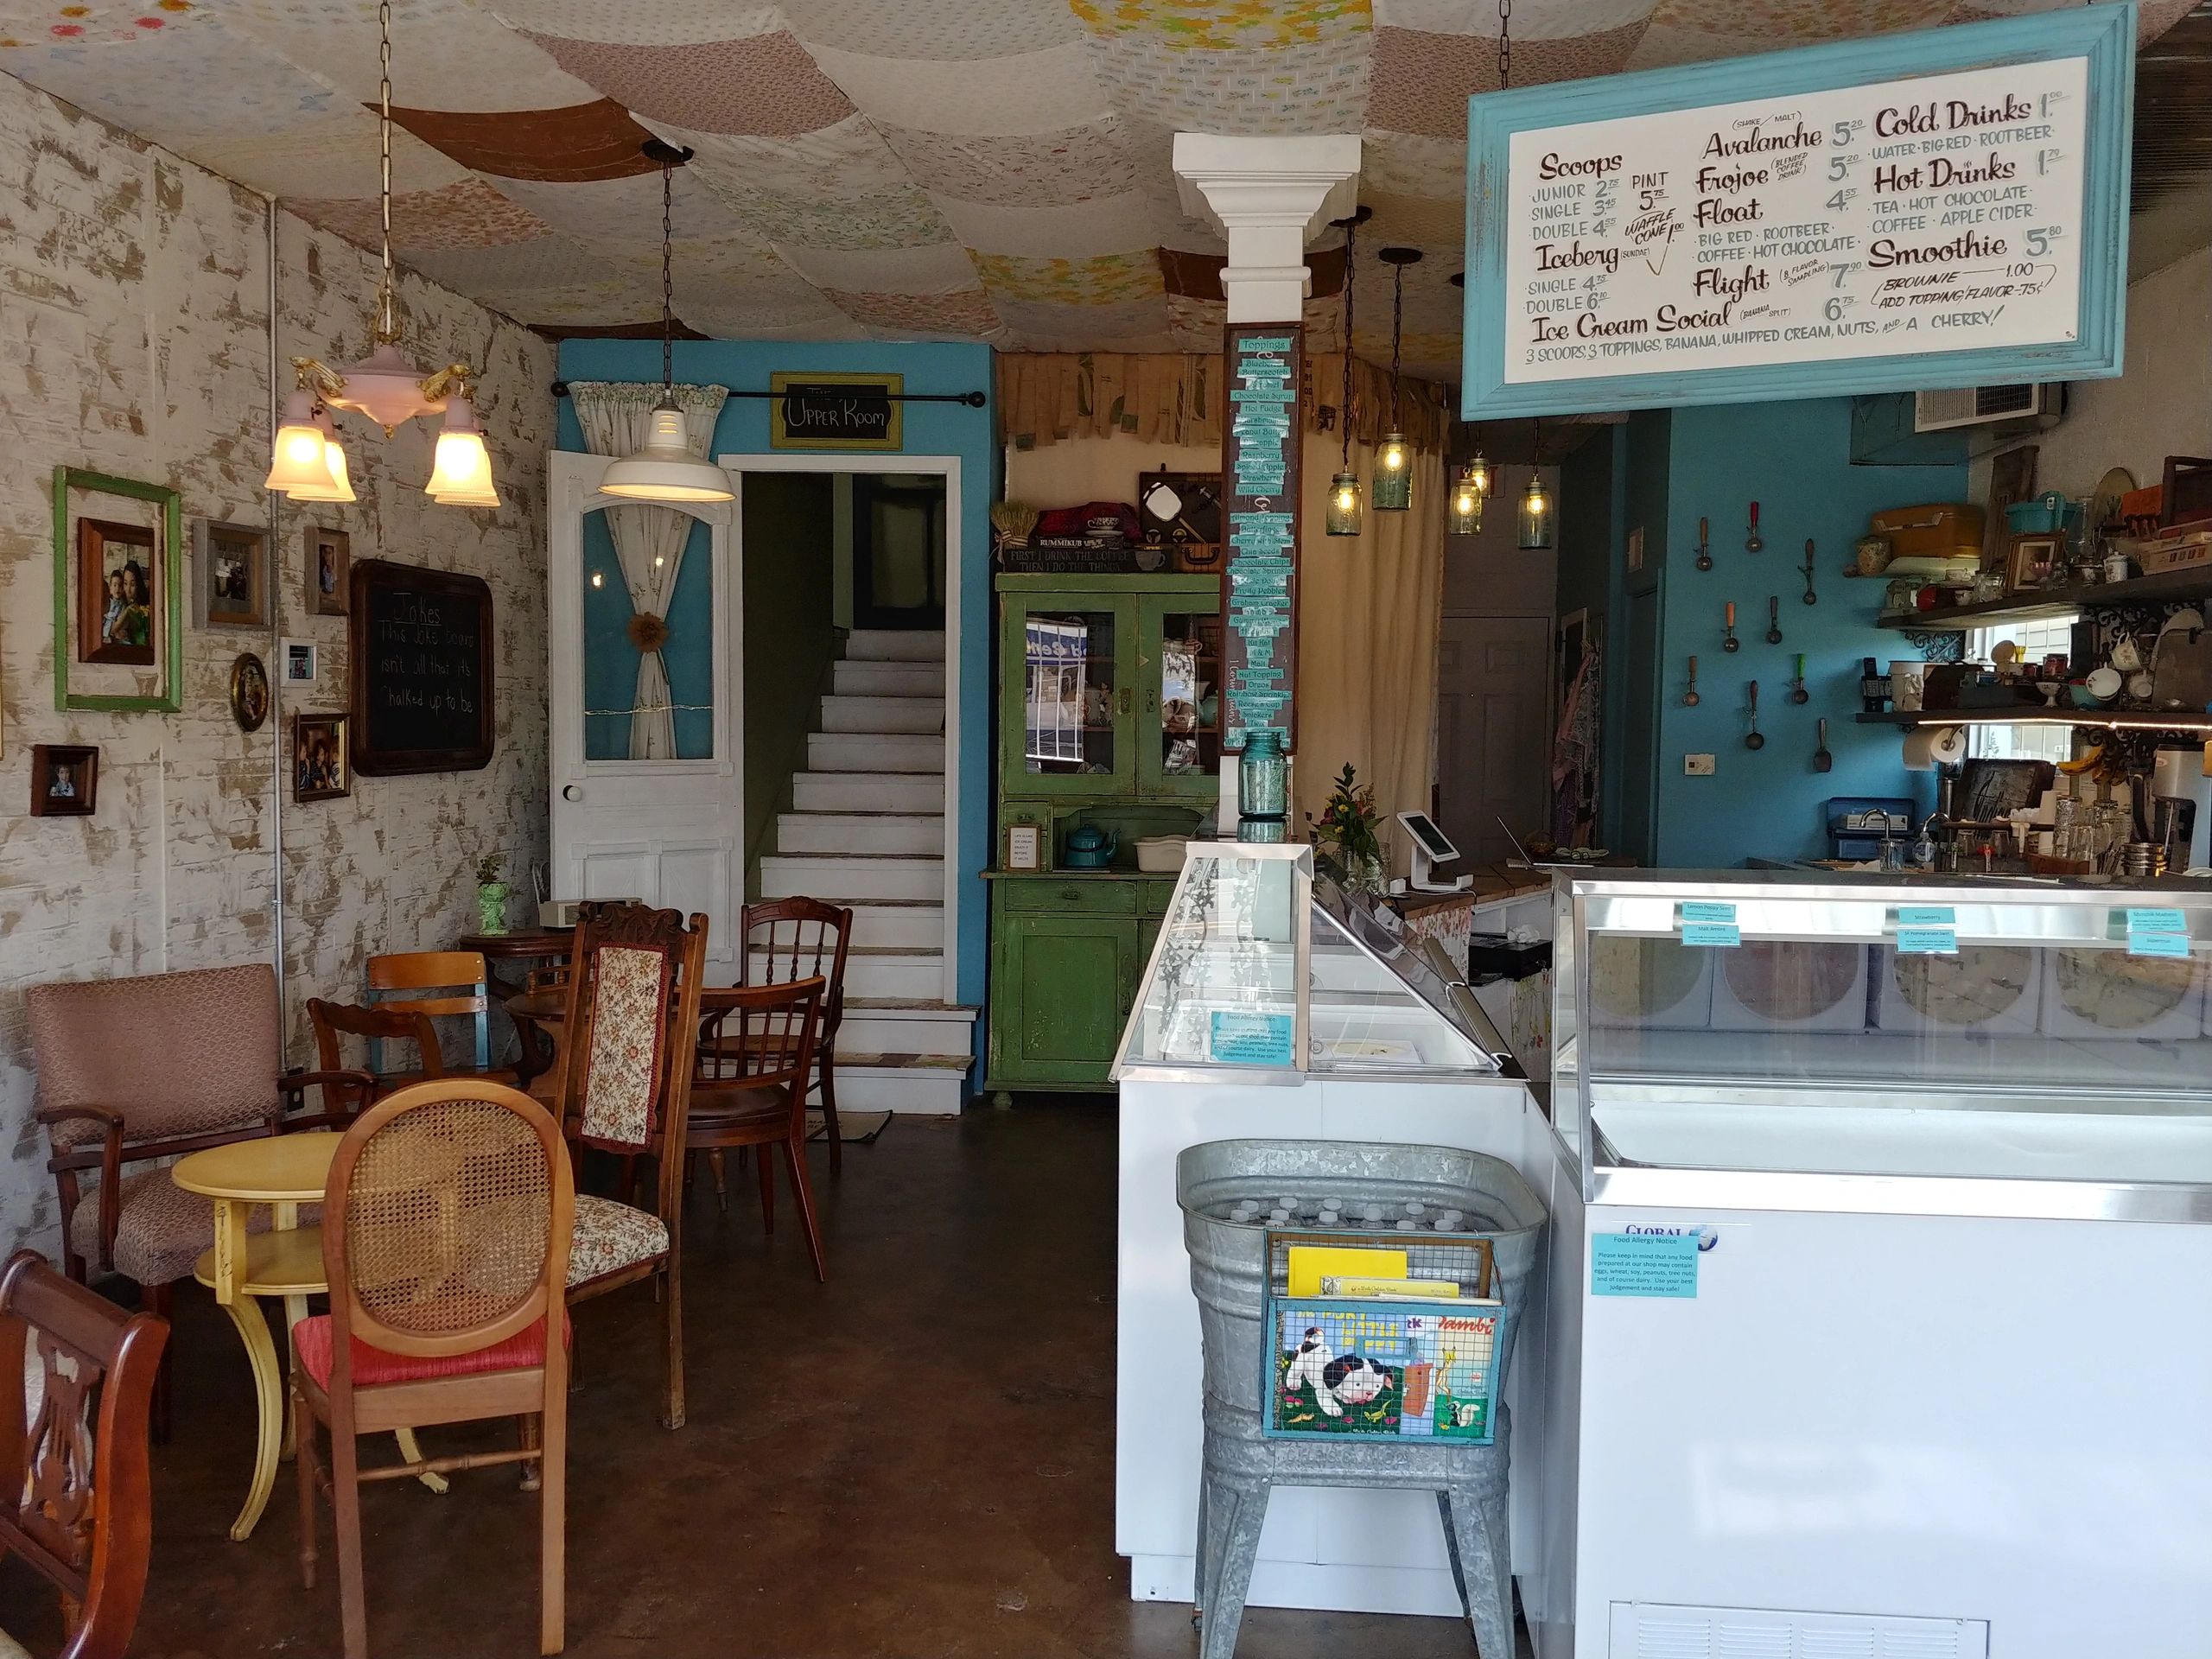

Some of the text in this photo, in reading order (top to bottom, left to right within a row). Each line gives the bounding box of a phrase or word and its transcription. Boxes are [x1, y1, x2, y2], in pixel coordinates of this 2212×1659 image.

[1875, 102, 1941, 138] Cold
[1946, 92, 2032, 130] Drinks
[1701, 121, 1823, 160] Avalanche
[1872, 143, 1916, 160] WATER
[1539, 152, 1669, 189] Scoops PINT
[1694, 162, 1770, 194] Frojoe
[1873, 163, 1925, 194] Hot
[1928, 151, 2017, 189] Drinks
[1532, 183, 1586, 203] JUNIOR
[1872, 184, 2029, 215] TEA HOT CHOCOLATE
[1531, 201, 1582, 221] SINGLE
[1693, 198, 1764, 229] Float
[1872, 202, 2033, 234] COFFEE APPLE CIDER
[1533, 219, 1590, 241] DOUBLE
[1624, 207, 1677, 237] WAFFLE
[1634, 223, 1668, 245] CONE
[1698, 232, 1724, 248] BIG
[1727, 230, 1753, 245] RED
[1535, 240, 1620, 274] Iceberg
[1697, 235, 1856, 264] COFFEE HOT CHOCOLATE
[1867, 229, 2008, 269] Smoothie
[2005, 262, 2034, 278] 1.00
[1527, 276, 1577, 296] SINGLE
[1692, 264, 1770, 304] Flight
[1790, 258, 1819, 275] FLAVOR
[1526, 296, 1584, 314] DOUBLE
[1878, 296, 1905, 309] ADD
[1531, 316, 1570, 344] Ice
[1576, 311, 1649, 339] Cream
[1656, 300, 1733, 334] Social
[1243, 340, 1286, 350] Toppings
[1525, 348, 1535, 365] 3
[1587, 344, 1599, 361] 3
[1721, 329, 1780, 346] WHIPPED
[1882, 317, 1901, 334] AND
[1905, 317, 1917, 332] A
[1234, 391, 1294, 401] Chocolate Syrup
[1260, 404, 1282, 414] Fudge
[1243, 451, 1280, 460] Raspberry
[1237, 485, 1281, 495] Wild Cherry
[1010, 550, 1035, 562] FIRST
[1258, 587, 1286, 595] Pebbles
[1252, 671, 1281, 679] Topping
[429, 695, 442, 718] up
[461, 688, 474, 713] be
[1243, 709, 1273, 718] Snickers
[1631, 1236, 1655, 1245] Allergy
